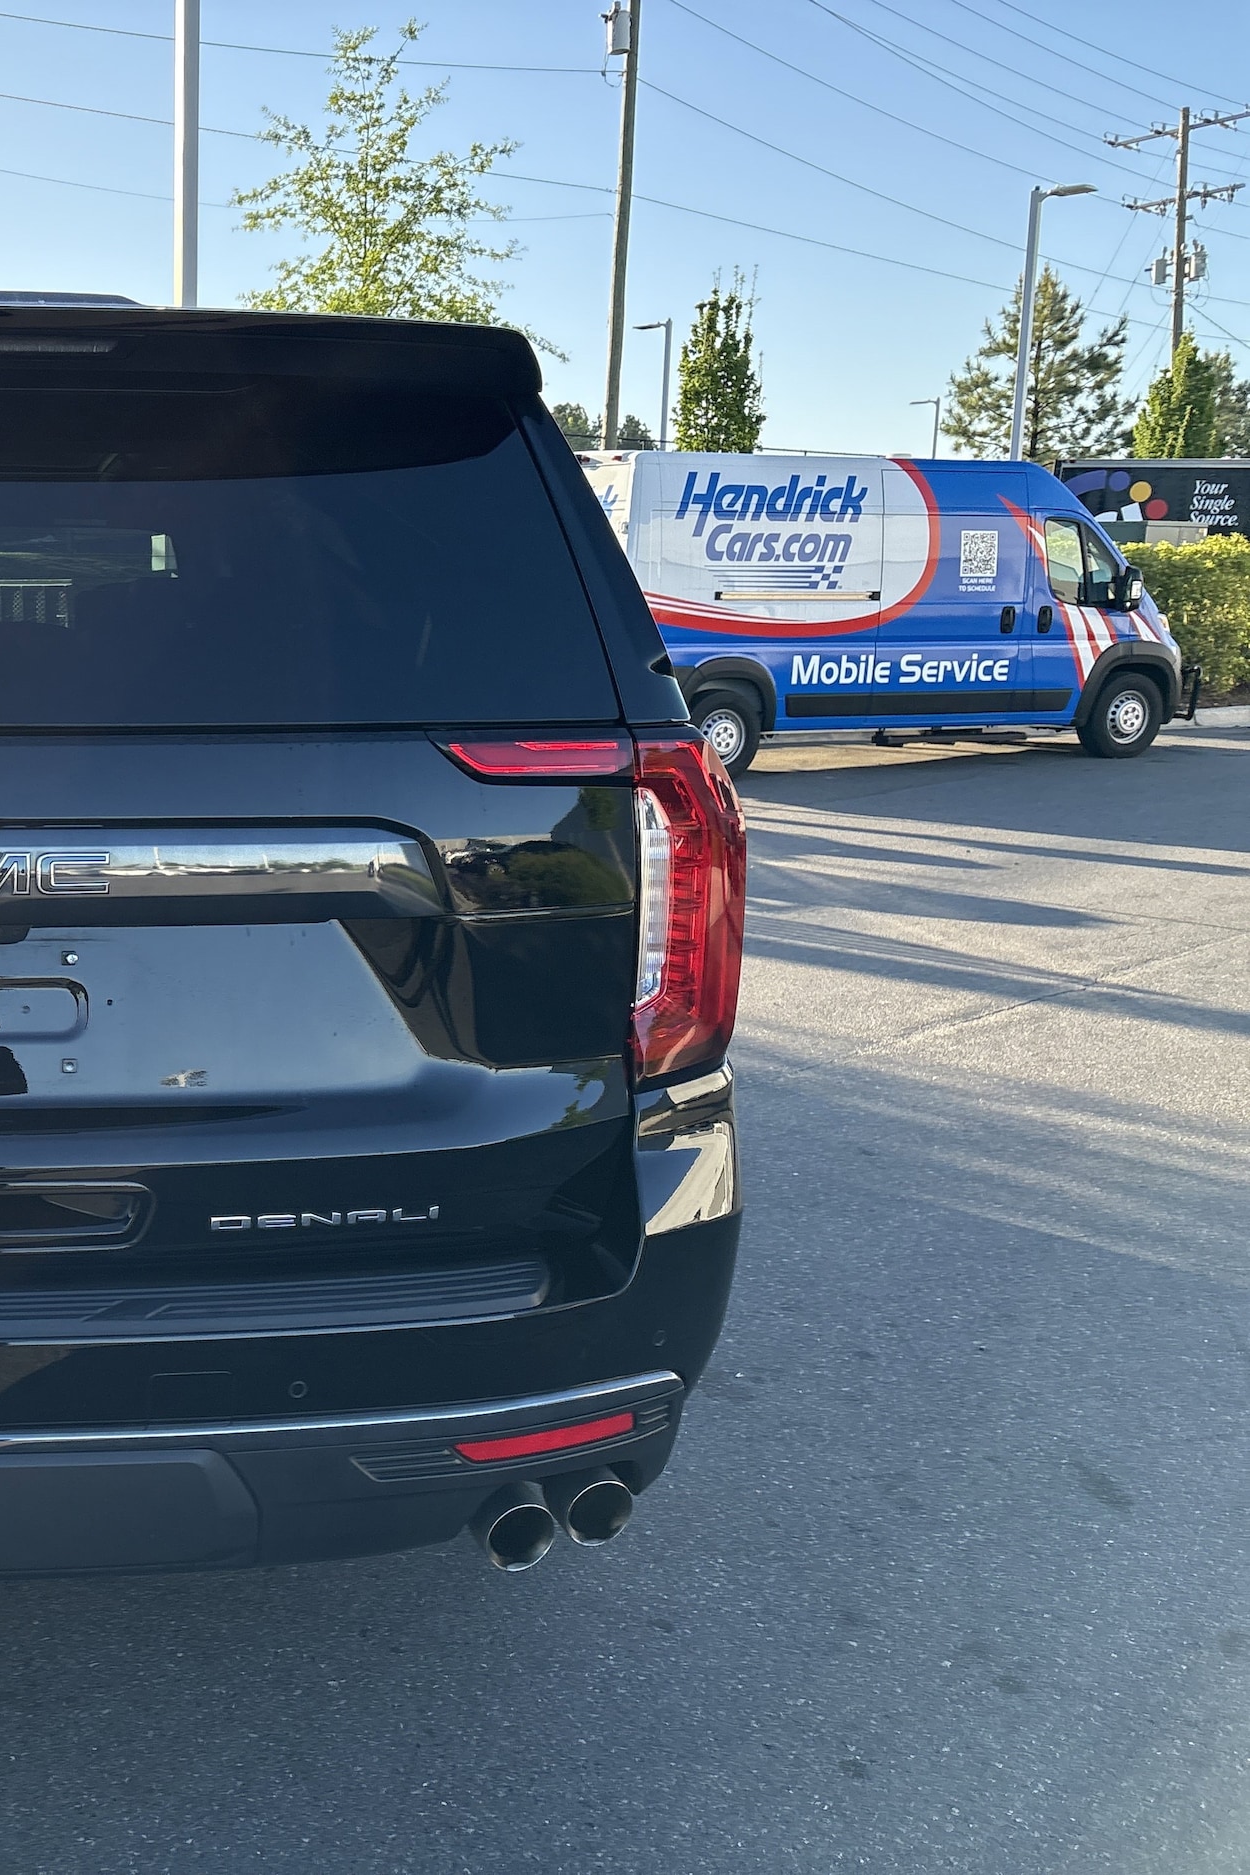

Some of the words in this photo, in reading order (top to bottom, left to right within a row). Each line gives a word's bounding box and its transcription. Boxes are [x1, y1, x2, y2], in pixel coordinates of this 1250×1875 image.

[1193, 480, 1229, 495] Your
[675, 471, 869, 537] Hendrick
[1190, 495, 1236, 515] Single
[1190, 510, 1239, 526] Source.
[705, 523, 853, 563] Cars.com
[791, 654, 891, 685] Mobile
[899, 653, 1010, 683] Service
[210, 1205, 440, 1230] DENALI
